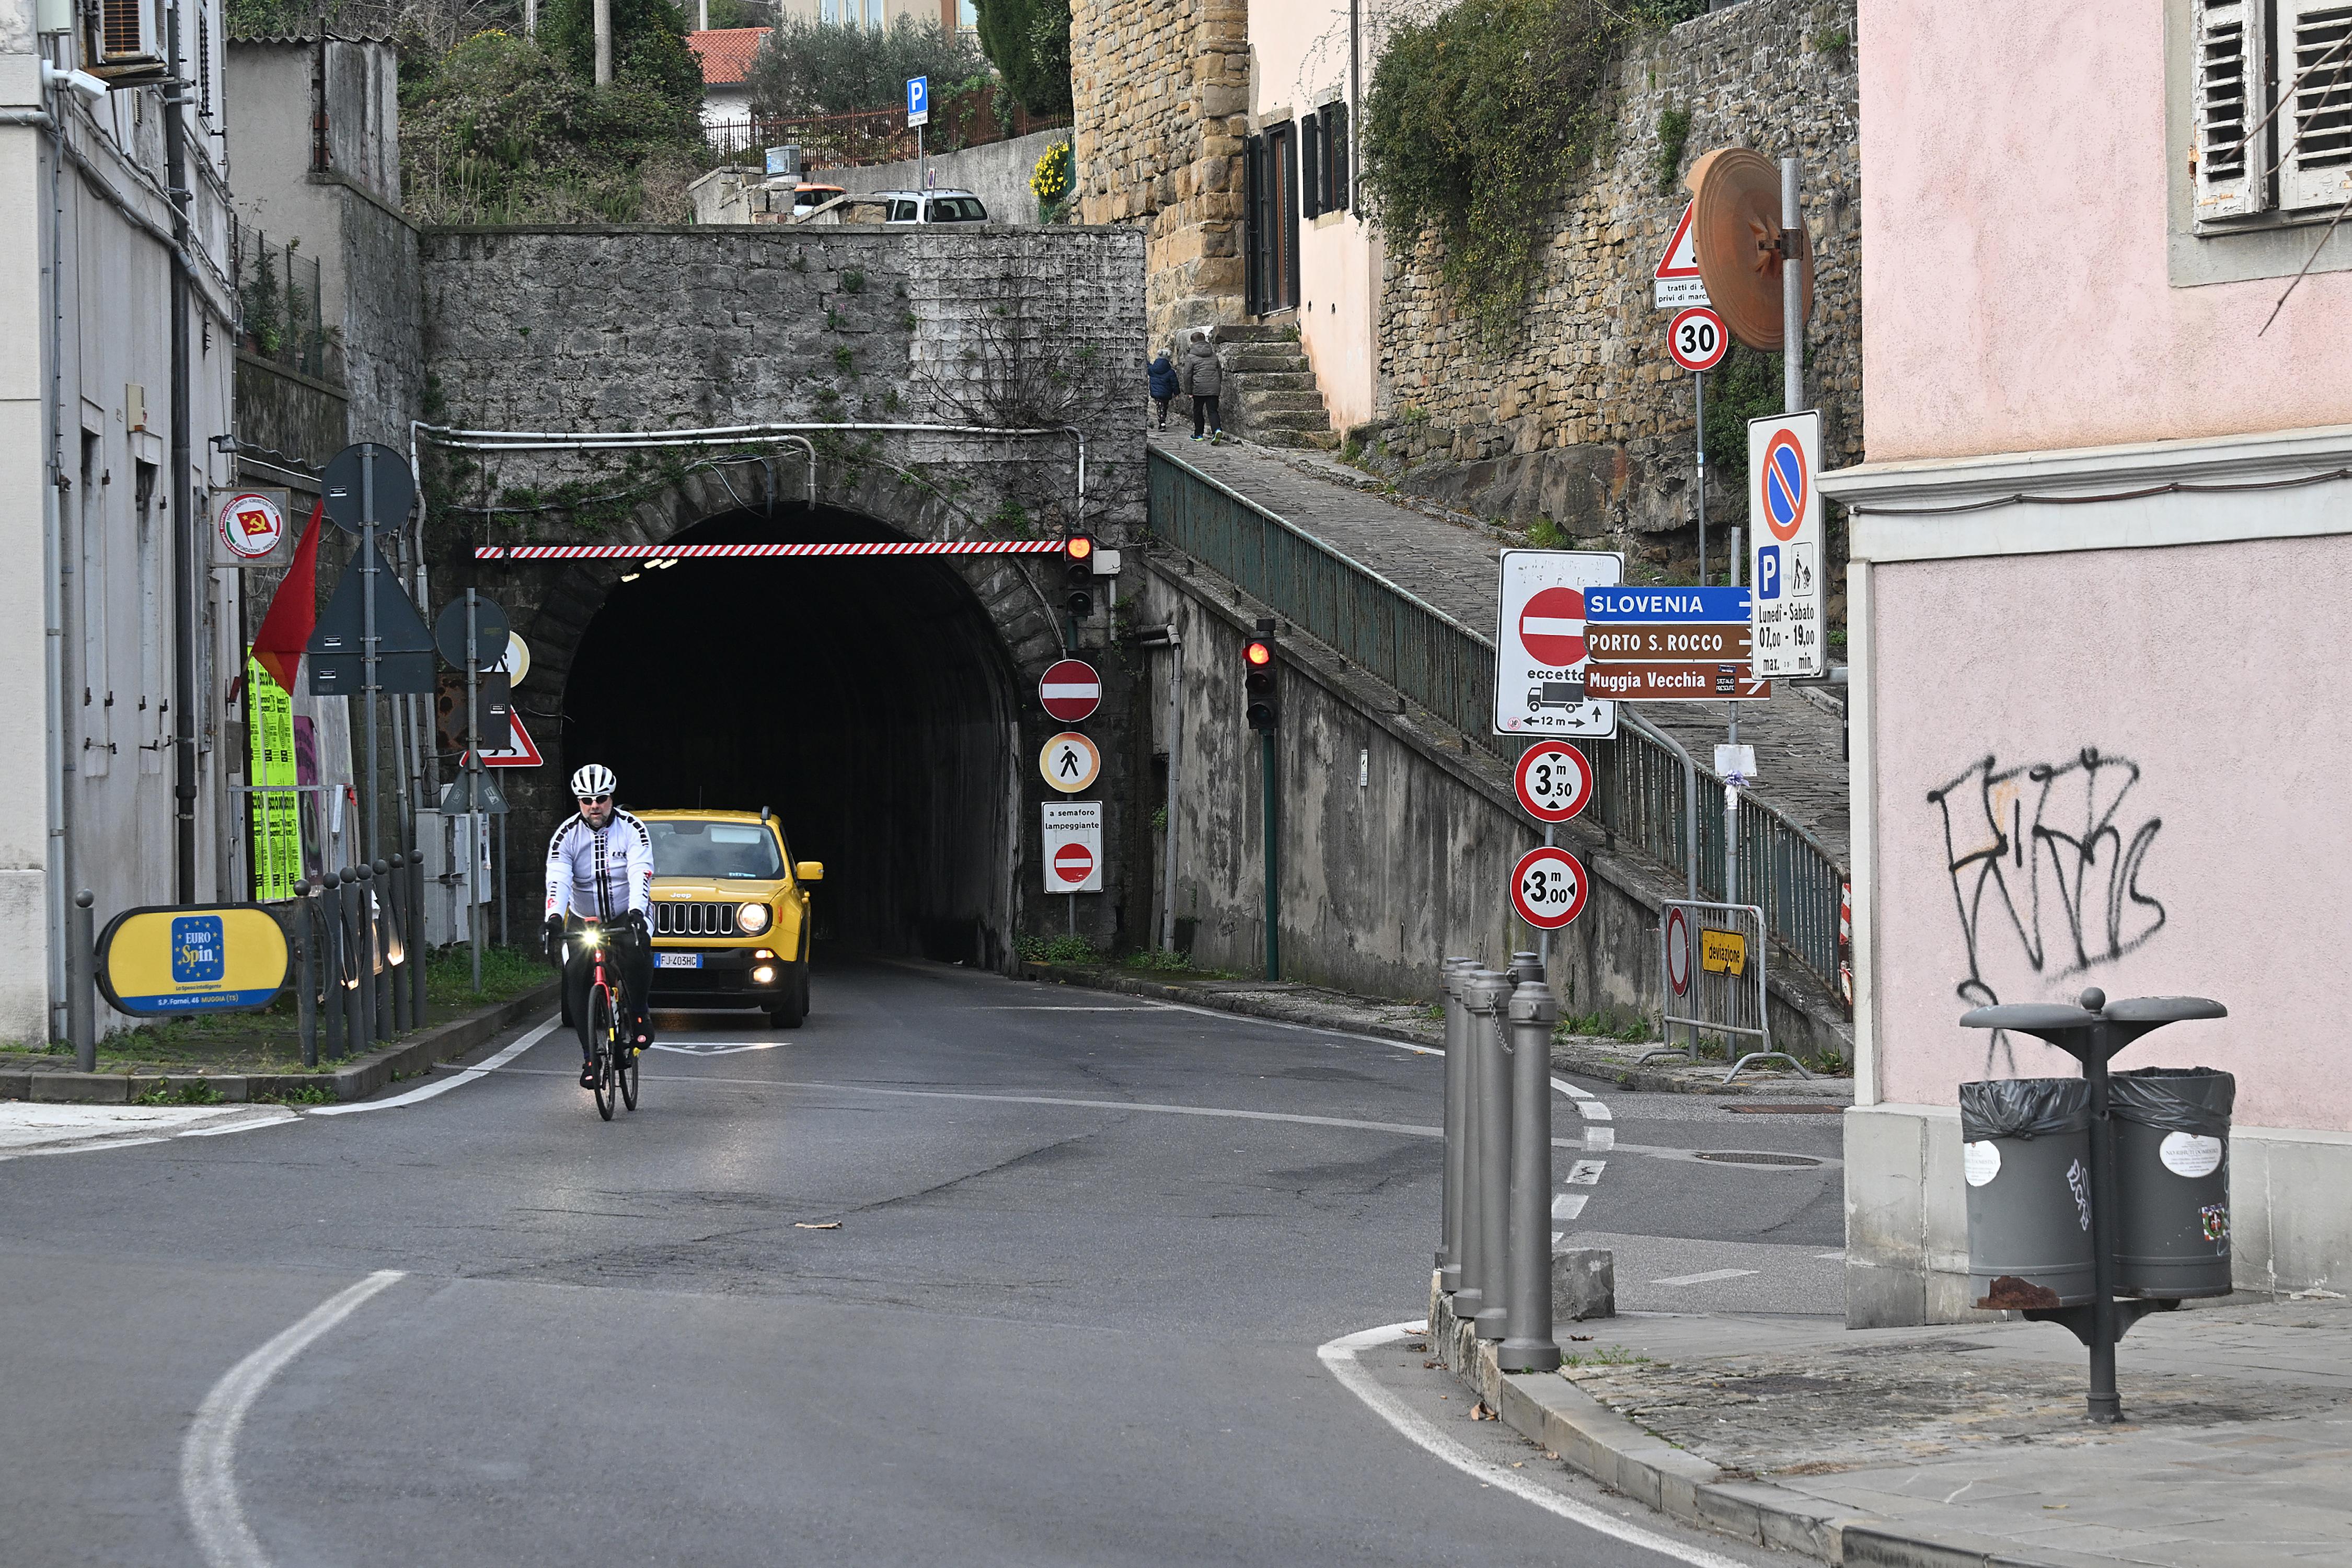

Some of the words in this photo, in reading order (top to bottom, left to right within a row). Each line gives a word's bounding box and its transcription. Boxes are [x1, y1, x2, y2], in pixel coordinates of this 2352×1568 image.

[912, 82, 923, 110] P
[1681, 324, 1714, 353] 30
[1763, 555, 1776, 592] P
[1590, 596, 1703, 613] SLOVENIA
[1789, 603, 1814, 621] Sabato
[1589, 634, 1641, 651] PORTO
[1648, 634, 1663, 651] S.
[1668, 634, 1722, 651] ROCCO
[1759, 627, 1781, 650] 07,00
[1794, 624, 1814, 648] 19,00
[1763, 659, 1779, 671] max.
[1798, 652, 1813, 669] min.
[1589, 671, 1641, 692] Muggia
[1647, 671, 1705, 687] Vecchia
[1541, 716, 1553, 726] 12
[1557, 765, 1566, 775] m
[1045, 822, 1099, 830] lampeggiante
[1551, 872, 1561, 882] m
[186, 932, 211, 944] EURO
[182, 944, 213, 967] Spin
[1709, 943, 1740, 964] deviazione
[226, 993, 239, 1002] (TS)
